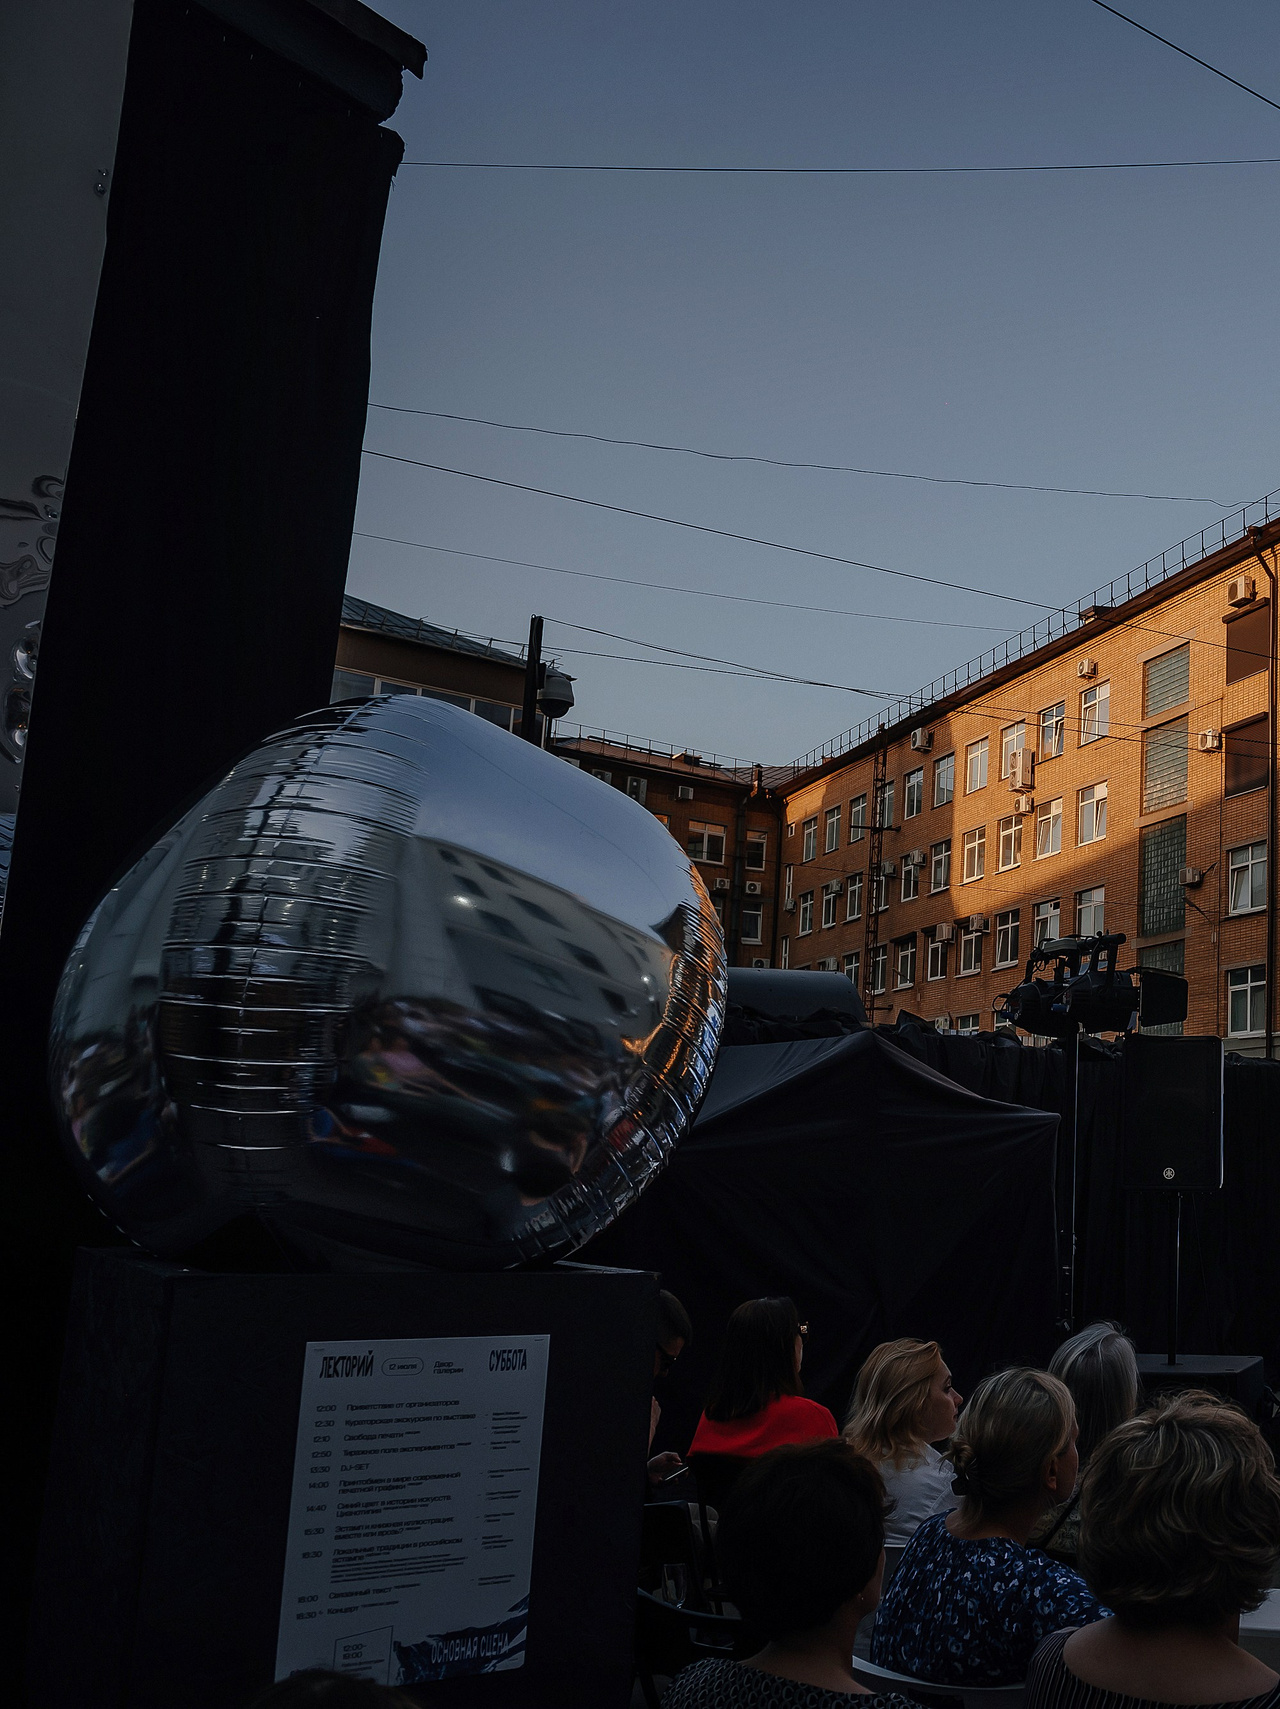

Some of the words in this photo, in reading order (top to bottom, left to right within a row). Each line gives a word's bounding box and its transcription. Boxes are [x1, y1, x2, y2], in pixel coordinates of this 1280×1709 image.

[319, 1350, 374, 1378] ЛЕКТОРИЙ
[489, 1349, 527, 1371] СУББОТА
[347, 1403, 395, 1411] Приветствие
[405, 1400, 460, 1408] организаторов
[345, 1418, 393, 1427] Кураторская
[394, 1415, 432, 1423] экскурсия
[344, 1433, 377, 1441] Свобода
[340, 1463, 370, 1472] DJ-SET
[308, 1481, 329, 1489] 14:00
[413, 1472, 461, 1481] современной
[338, 1485, 374, 1494] печатной
[374, 1484, 406, 1492] графики
[337, 1501, 361, 1510] Синий
[370, 1521, 403, 1529] книжная
[333, 1547, 375, 1556] Локальные
[376, 1542, 412, 1551] традиции
[418, 1538, 463, 1548] российском
[372, 1587, 392, 1595] текст
[327, 1606, 360, 1615] Концерт
[431, 1636, 478, 1664] ОСНОВНАЯ
[480, 1632, 509, 1658] СЦЕНА
